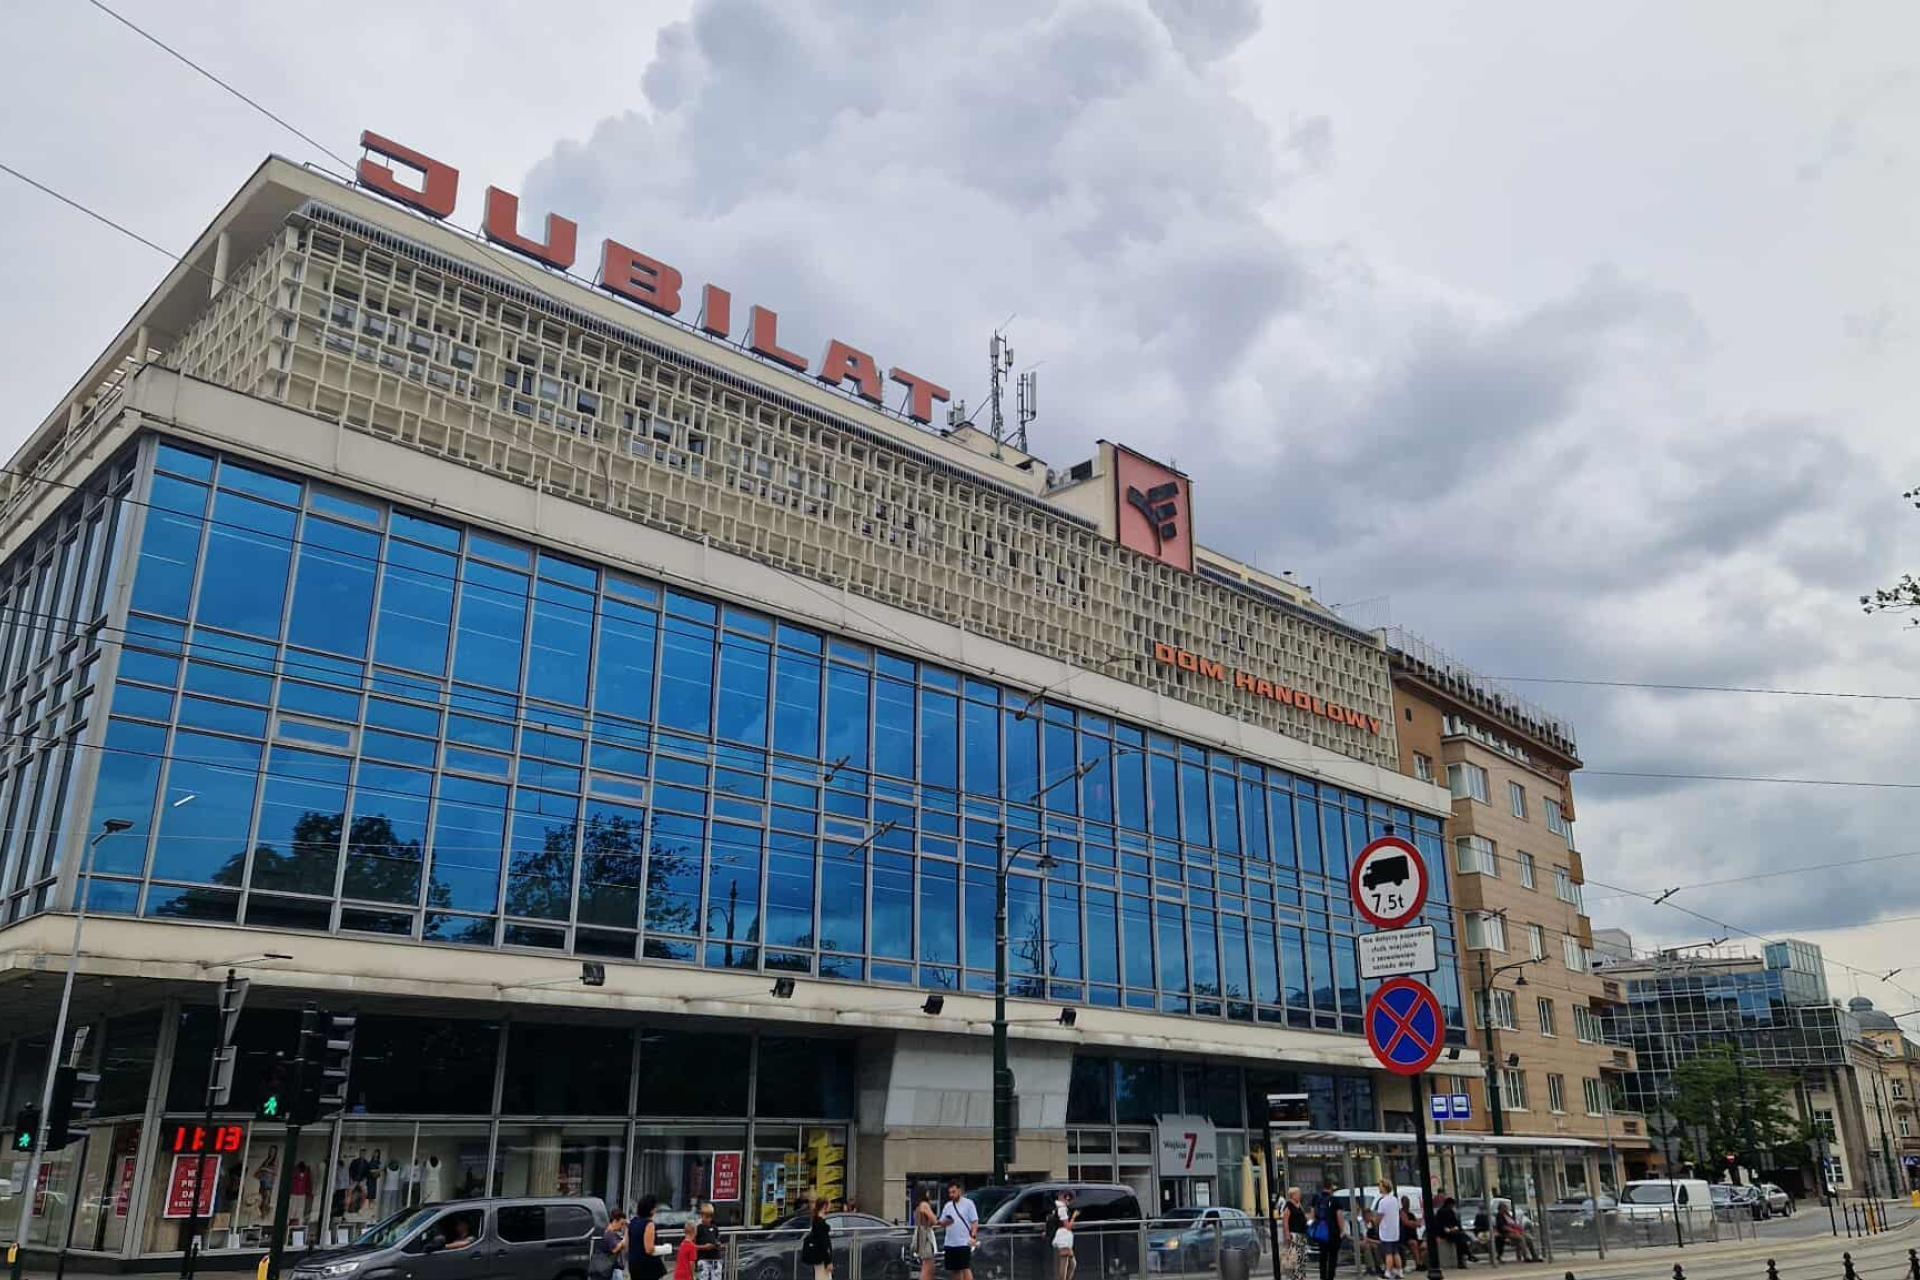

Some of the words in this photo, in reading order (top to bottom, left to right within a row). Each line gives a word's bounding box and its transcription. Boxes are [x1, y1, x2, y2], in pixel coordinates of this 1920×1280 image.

[356, 130, 950, 425] JUBILAT
[1154, 642, 1226, 682] DOM
[1235, 669, 1382, 736] HANDLOWY
[1371, 892, 1405, 914] 7,5t
[173, 1126, 243, 1152] 11:13
[1184, 1132, 1197, 1169] 7
